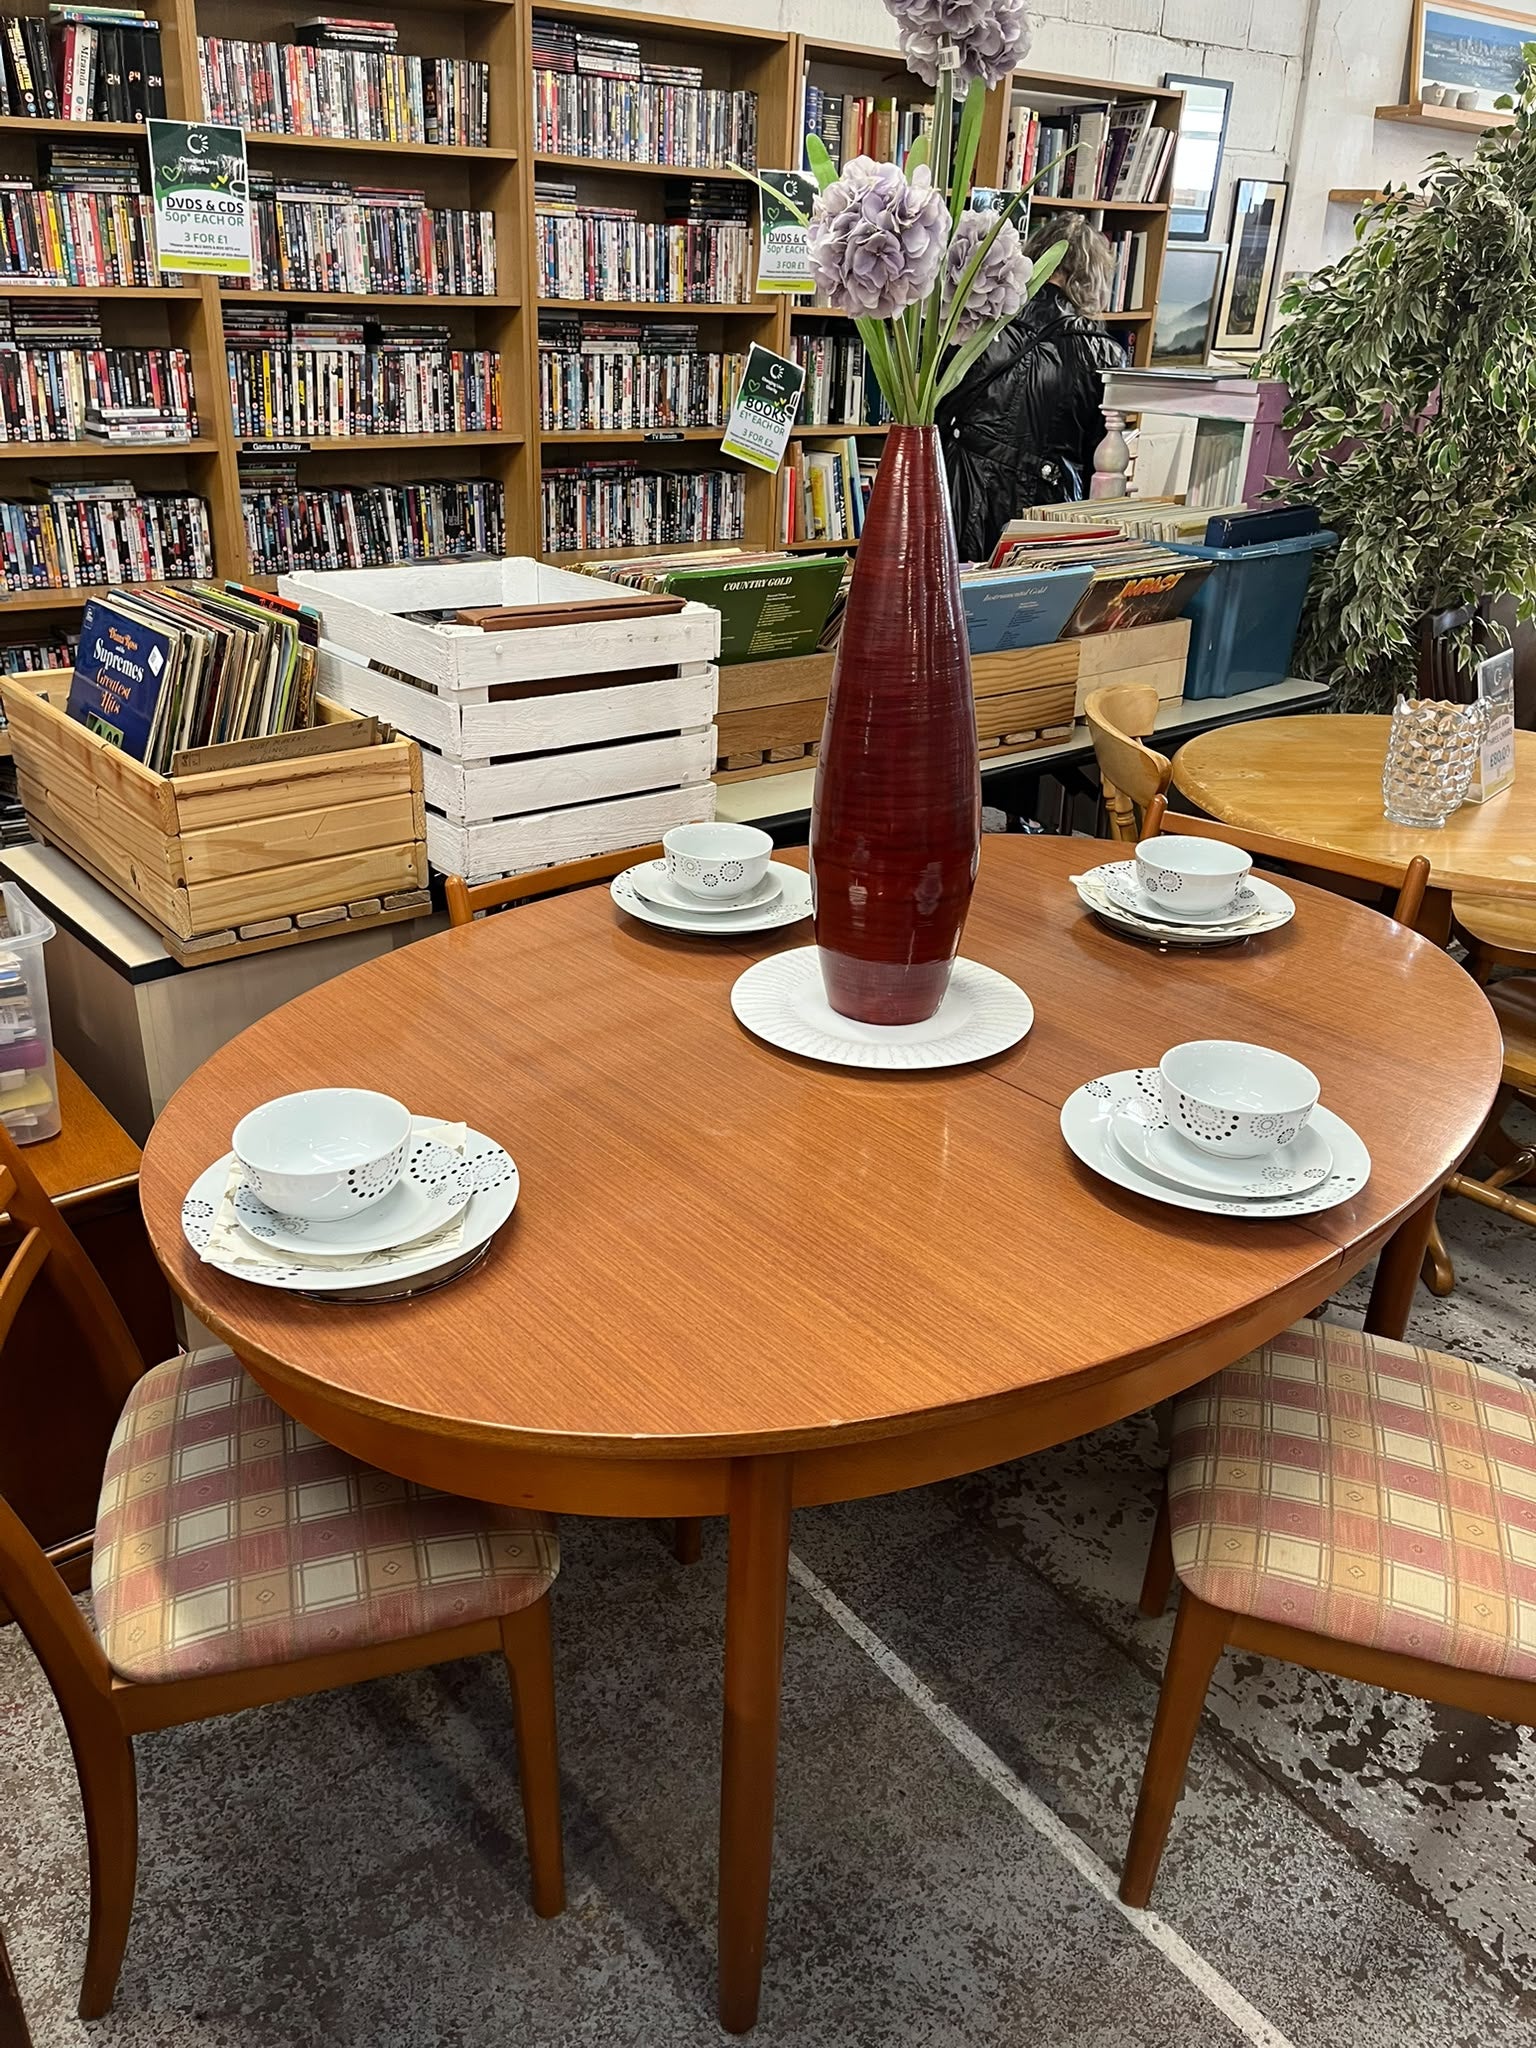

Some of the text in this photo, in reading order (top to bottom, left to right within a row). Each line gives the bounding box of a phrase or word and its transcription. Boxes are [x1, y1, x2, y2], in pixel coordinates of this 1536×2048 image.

[13, 29, 26, 56] MICHAEL
[80, 44, 89, 86] Miranda
[108, 74, 120, 85] 24
[128, 71, 141, 82] 24
[148, 76, 162, 87] 24
[166, 196, 244, 213] DVDS & CDS
[194, 214, 224, 226] EACH
[228, 216, 244, 227] OR
[184, 232, 228, 244] 3 FOR £1
[769, 232, 792, 243] DVDS
[794, 234, 799, 243] &
[785, 245, 805, 254] EACH
[776, 261, 805, 269] 3 FOR £1
[816, 353, 824, 377] Paula
[57, 377, 65, 407] LIMITLESS
[746, 396, 788, 423] BOOKS
[751, 414, 773, 430] EACH
[774, 427, 785, 436] OR
[748, 430, 763, 443] FOR
[764, 437, 774, 447] £2
[276, 443, 281, 451] &
[282, 443, 302, 452] Bluray
[81, 529, 91, 548] RUSH
[184, 523, 193, 547] SALT
[723, 576, 792, 591] COUNTRY GOLD
[1122, 572, 1186, 598] IMPACT
[983, 586, 1048, 602] Instrumental Gold
[93, 638, 144, 682] Supremes
[96, 668, 132, 700] Greatest
[101, 690, 120, 714] Hits
